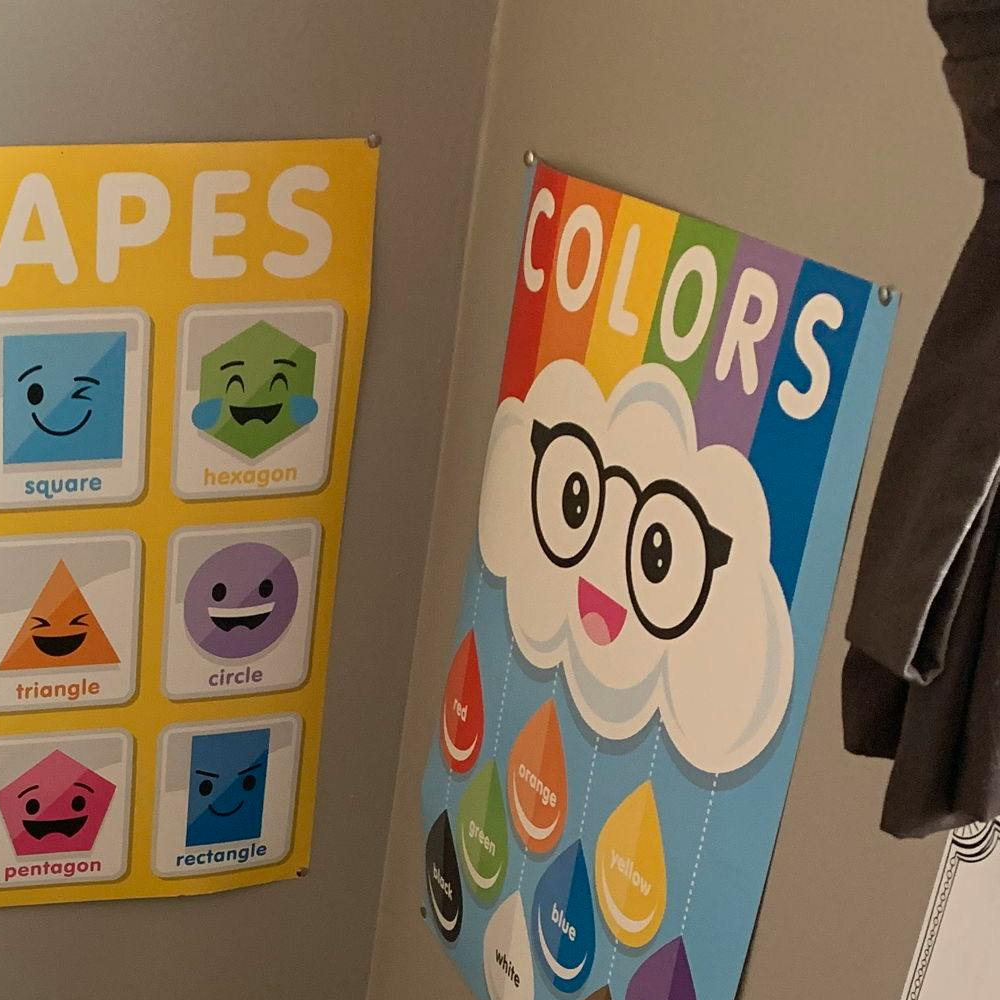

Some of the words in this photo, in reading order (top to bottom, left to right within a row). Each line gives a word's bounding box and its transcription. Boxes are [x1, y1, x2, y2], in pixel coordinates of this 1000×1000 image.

[523, 187, 844, 420] COLORS
[24, 474, 102, 500] square
[202, 465, 298, 488] hexagon
[15, 679, 101, 702] triangle
[208, 665, 263, 688] circle
[452, 699, 468, 721] red
[518, 763, 557, 807] orange
[468, 820, 496, 857] green
[4, 857, 101, 882] pentagon
[175, 842, 267, 868] rectangle
[432, 862, 454, 901] black
[609, 850, 652, 897] yellow
[551, 902, 577, 941] blue
[495, 949, 520, 988] white
